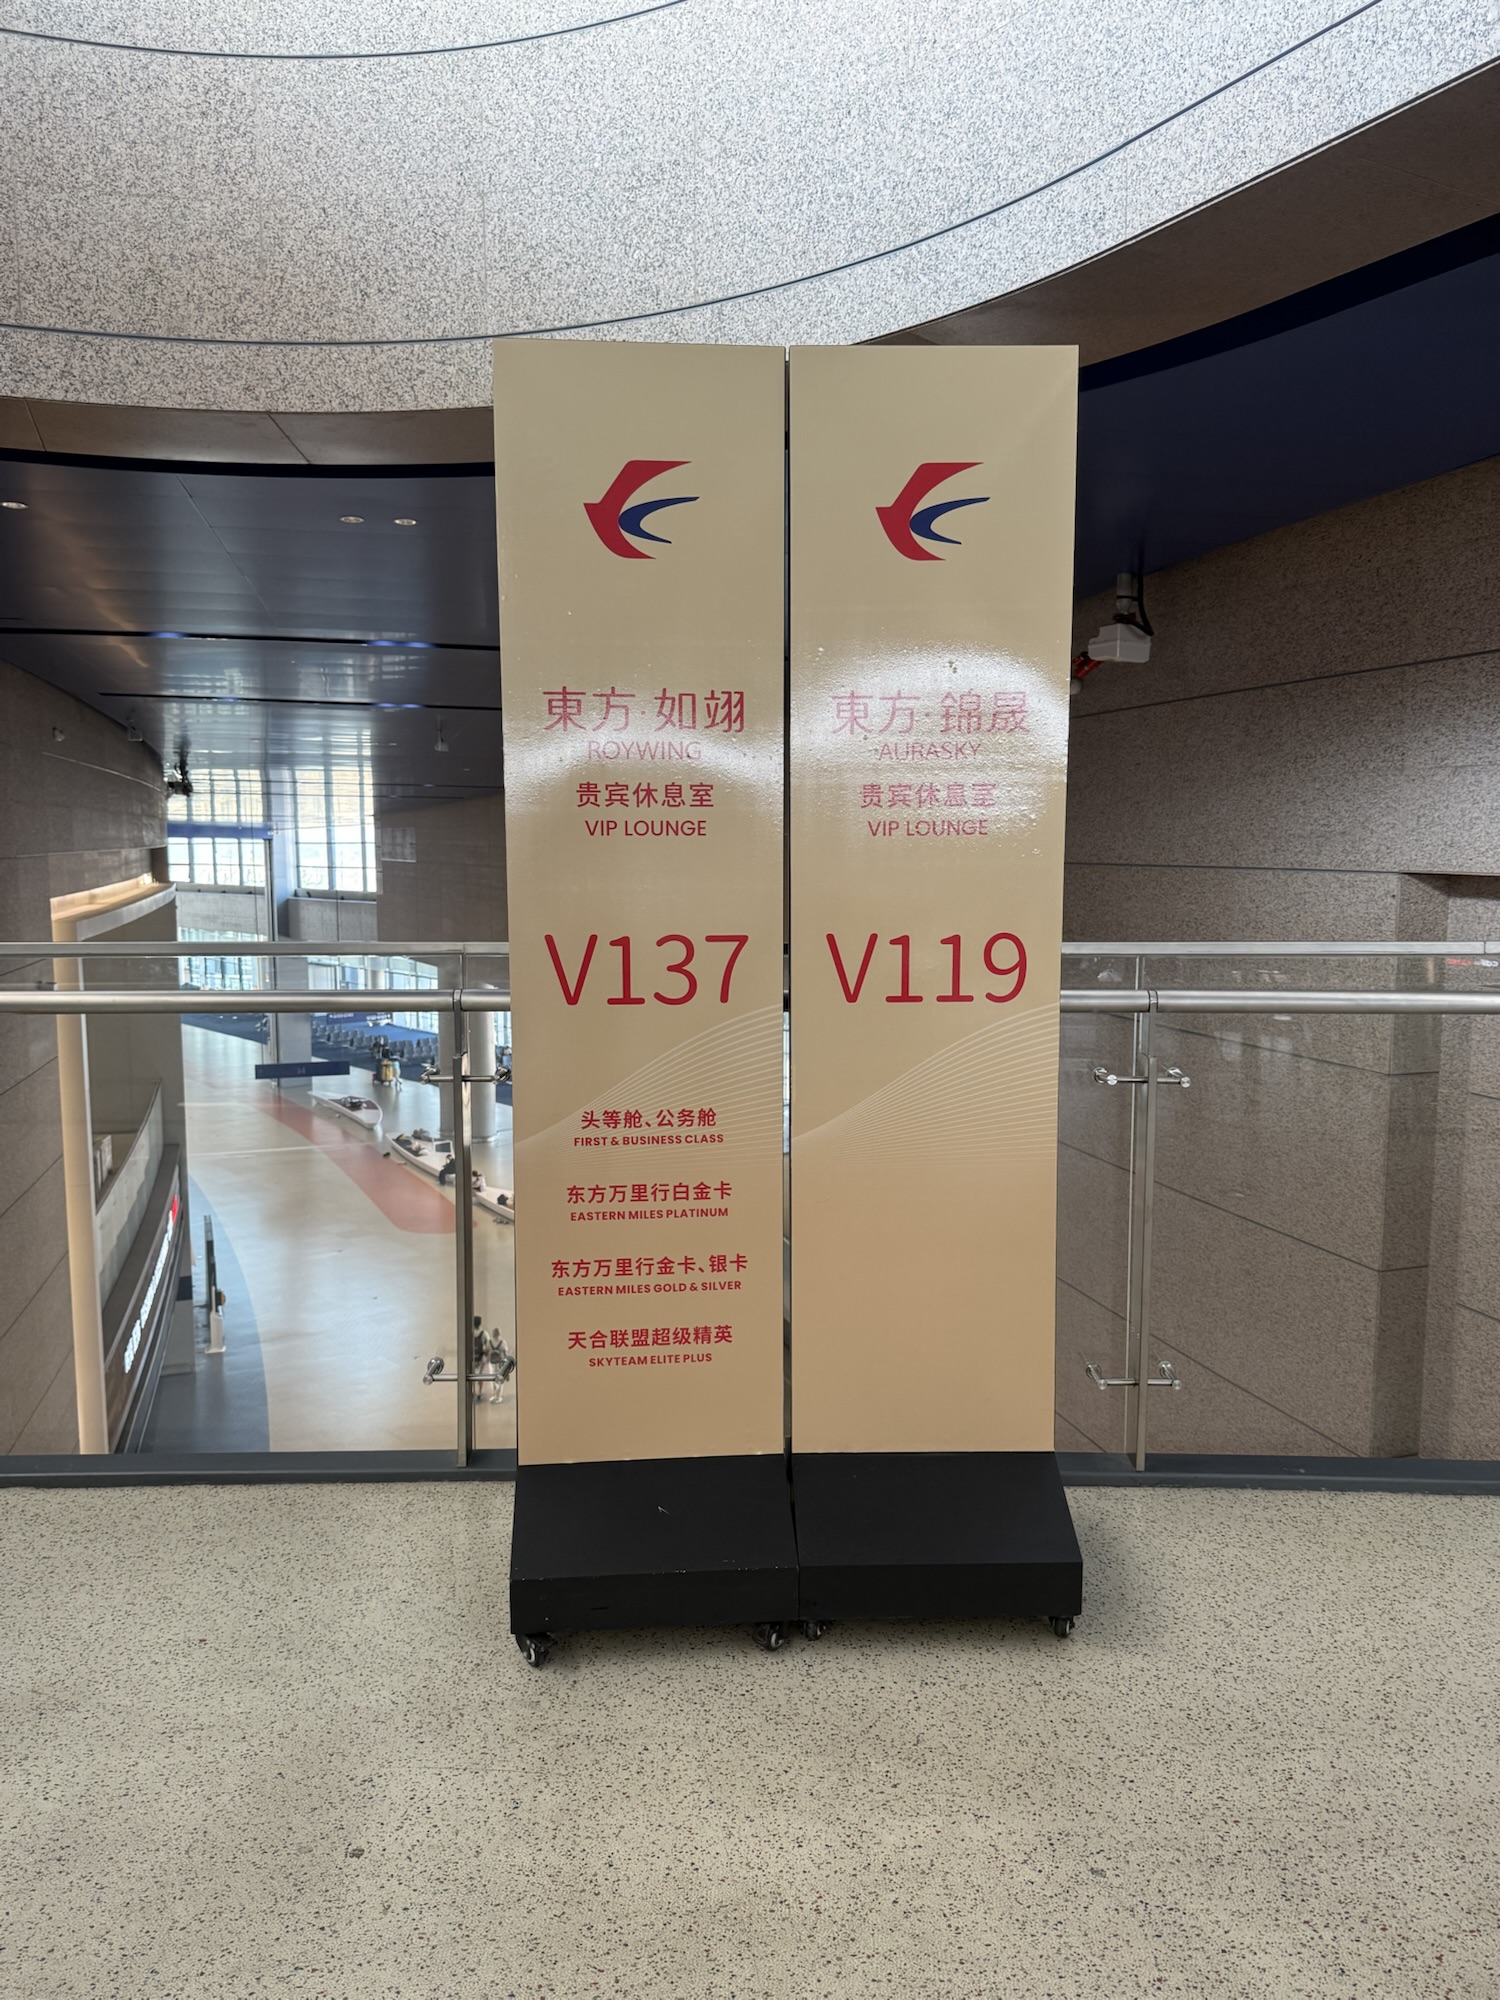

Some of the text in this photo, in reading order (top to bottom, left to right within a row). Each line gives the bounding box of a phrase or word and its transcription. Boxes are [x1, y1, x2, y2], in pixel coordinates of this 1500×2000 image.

[588, 740, 702, 761] ROYWING
[879, 741, 981, 761] AURASKY
[577, 782, 714, 808] 贵宾休息室
[860, 782, 997, 809] 贵宾休息室
[585, 819, 706, 837] VIP LOUNGE
[867, 819, 989, 837] VIP LOUNGE
[544, 933, 749, 1006] V137
[825, 931, 1028, 1004] V119
[581, 1107, 717, 1130] 头等舱、公务舱
[573, 1133, 725, 1147] FIRST & BUSINESS CLASS
[566, 1181, 732, 1205] 东方万里行白金卡
[570, 1207, 729, 1222] EASTERN MILES PLATINUM
[551, 1253, 748, 1279] 东方万里行金卡、银卡
[557, 1280, 742, 1297] EASTERN MILES GOLD & SILVER
[567, 1324, 733, 1350] 天合联盟超级精英
[588, 1352, 713, 1368] SKYTEAM ELITE PLUS
